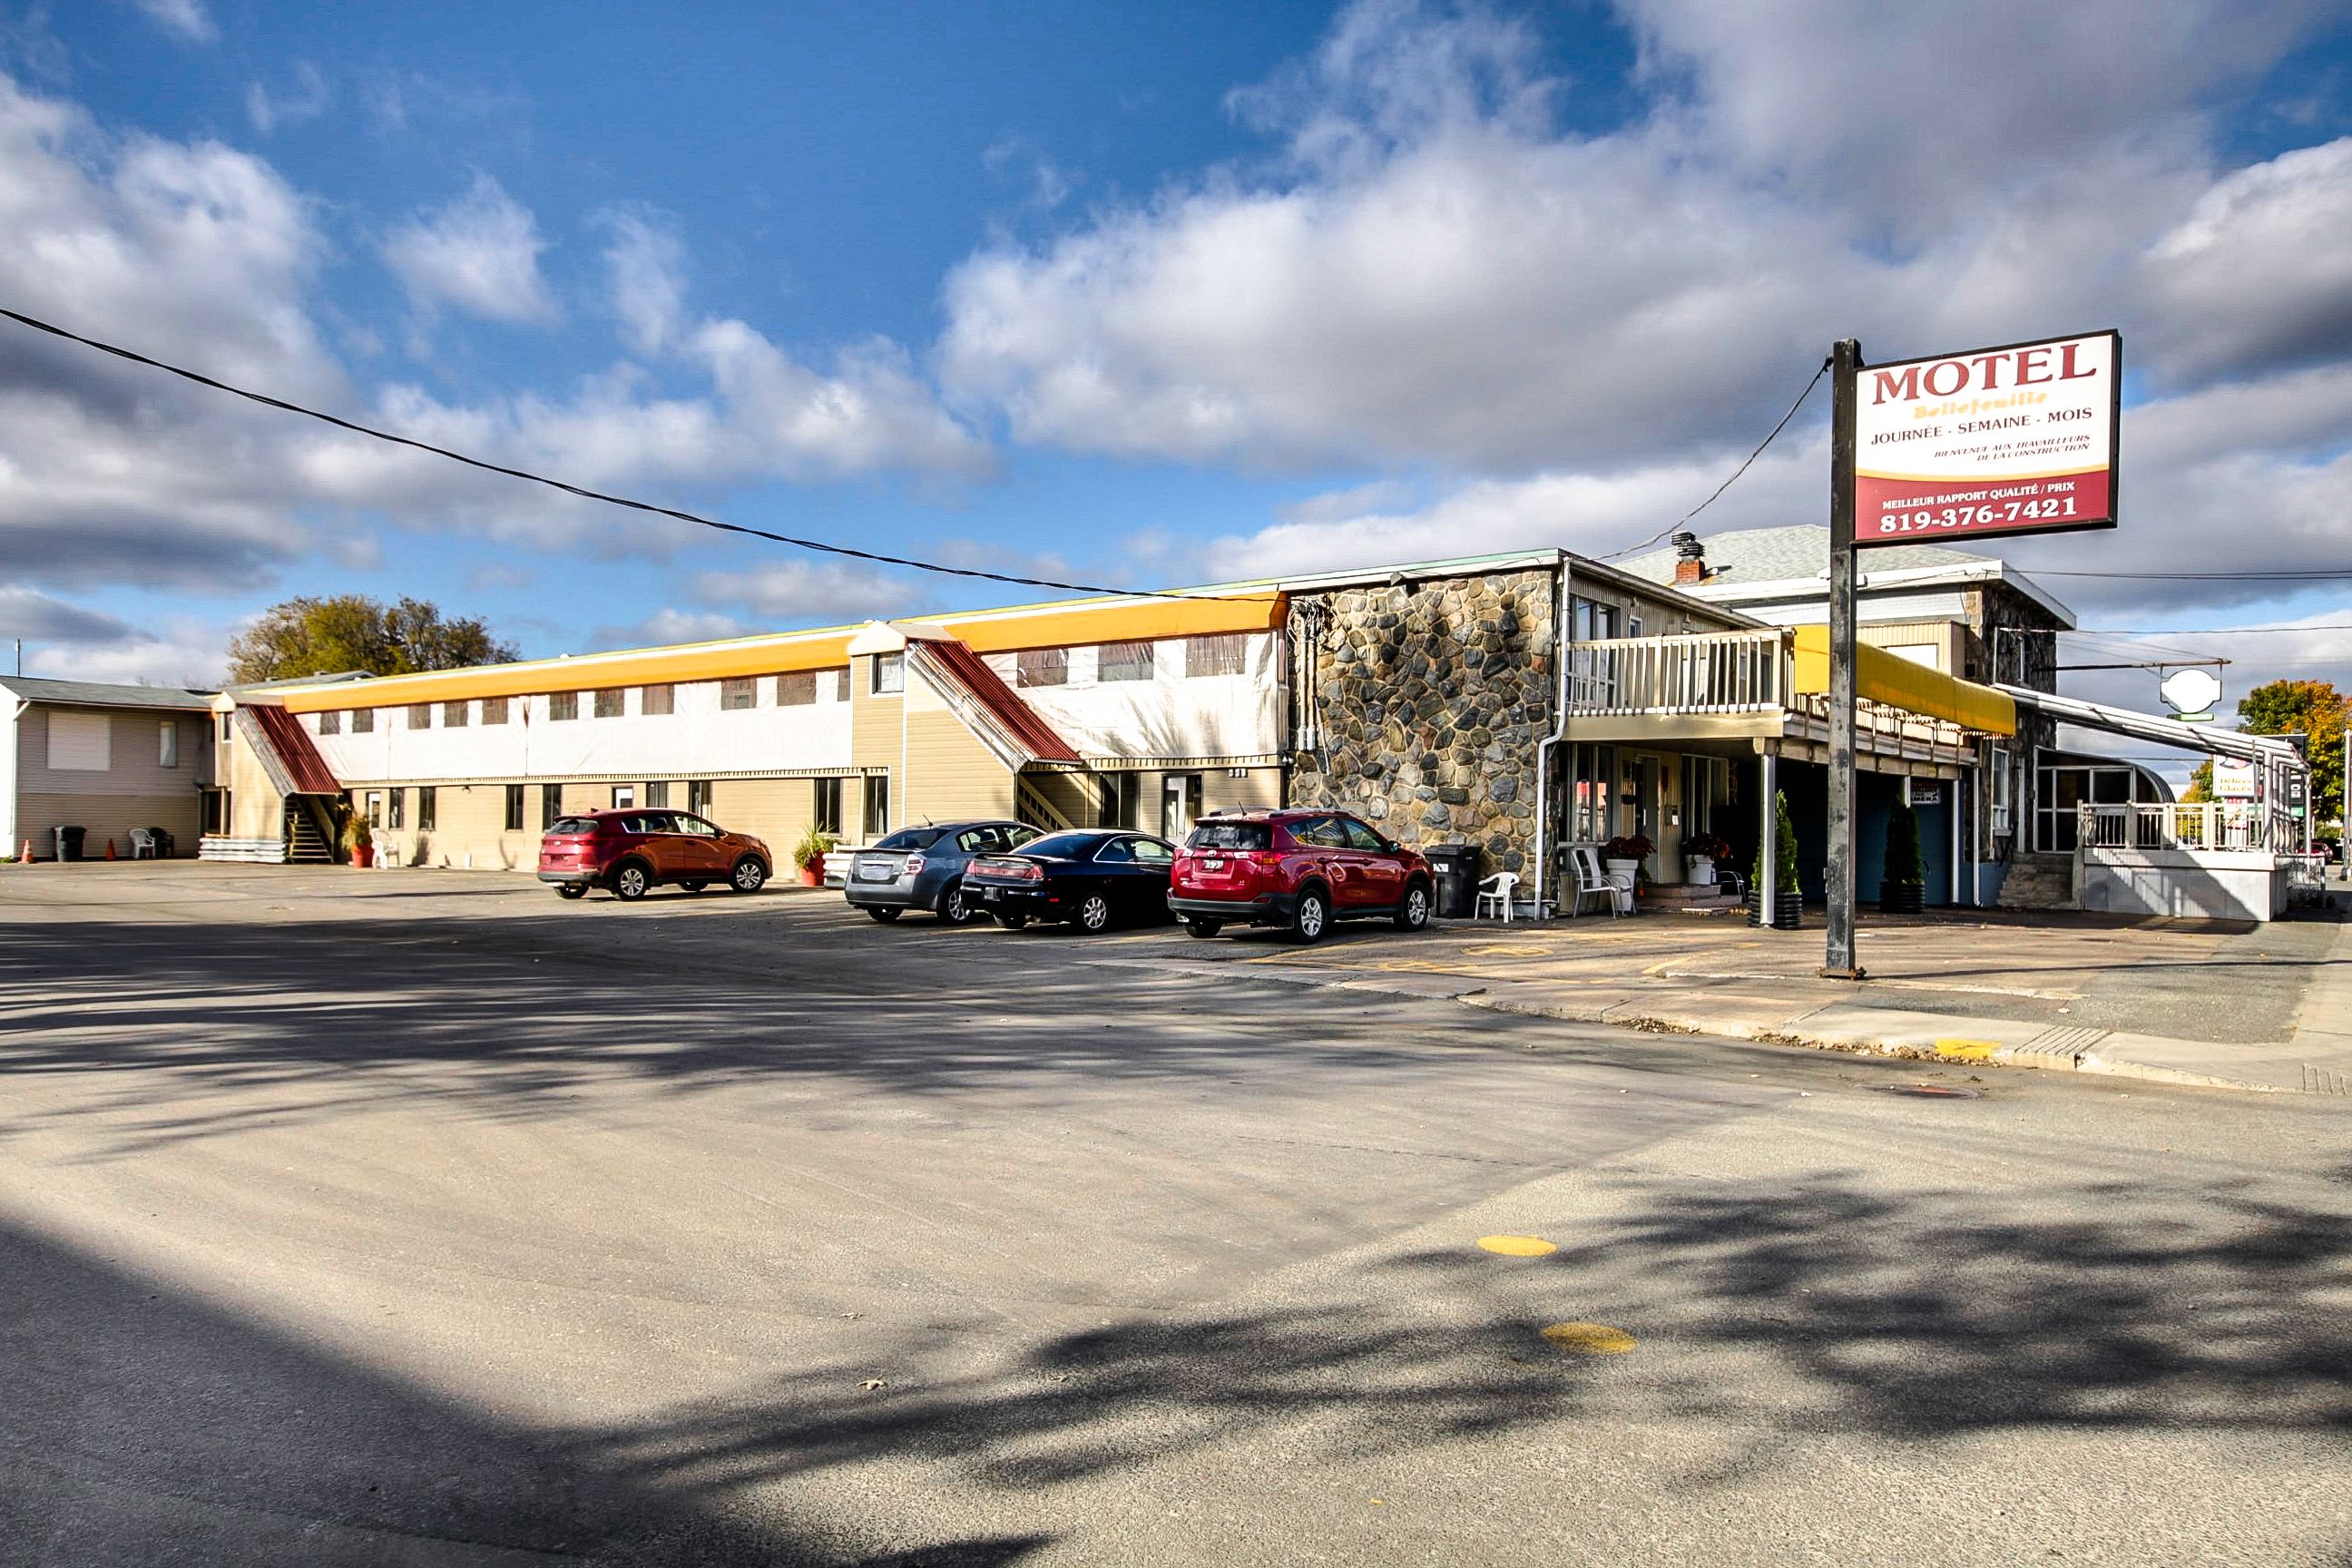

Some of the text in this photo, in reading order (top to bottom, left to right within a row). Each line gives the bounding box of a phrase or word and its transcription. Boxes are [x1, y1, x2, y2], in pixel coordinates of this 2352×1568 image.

[1872, 344, 2097, 405] MOTEL
[1914, 391, 2048, 419] Bellefeuille
[1871, 424, 1943, 446] JOURNÉE
[1957, 415, 2031, 435] SEMAINE
[2047, 407, 2092, 424] MOIS
[1934, 434, 2091, 458] BIENVENUE AUX TRAVAILLEURS
[1976, 443, 2090, 462] DE LA CONSTRUCTION
[1882, 496, 1935, 510] MEILLEUR
[1936, 491, 1988, 505] RAPPORT
[1990, 483, 2039, 500] QUALITÉ
[2047, 481, 2075, 492] PRIX
[1879, 496, 2077, 533] 819-376-7421
